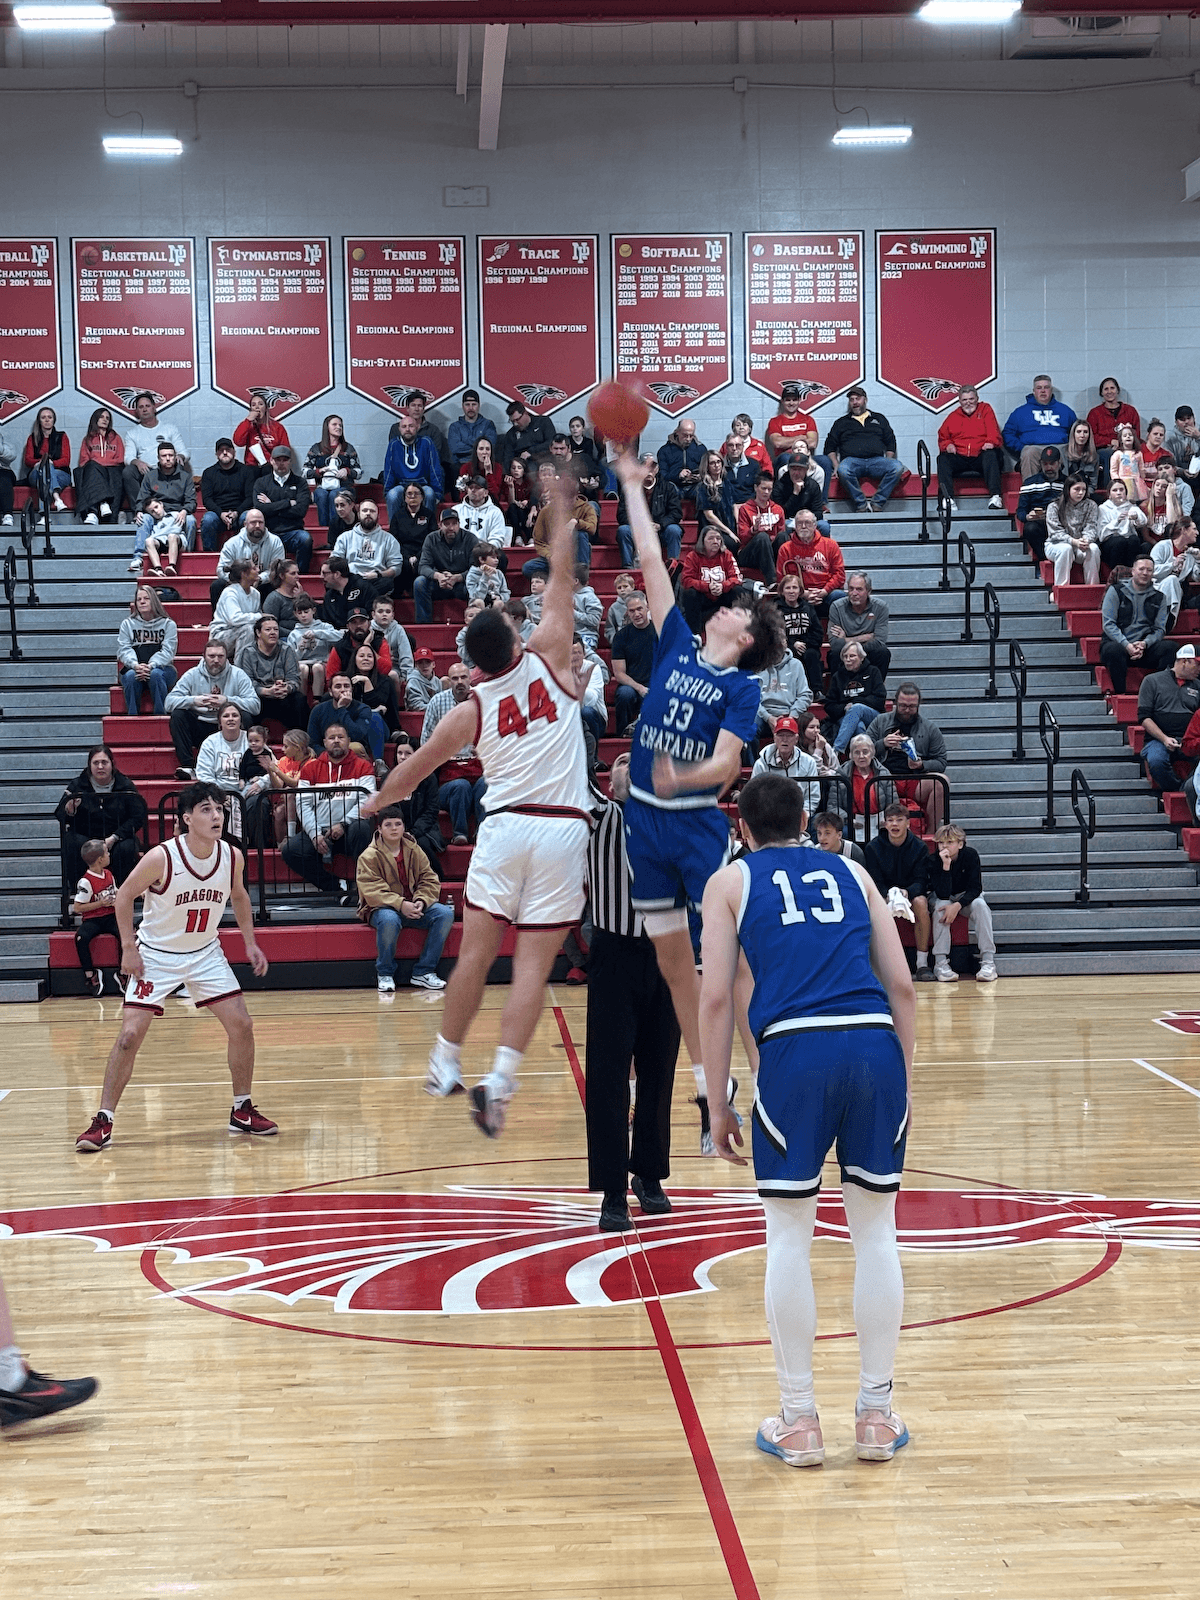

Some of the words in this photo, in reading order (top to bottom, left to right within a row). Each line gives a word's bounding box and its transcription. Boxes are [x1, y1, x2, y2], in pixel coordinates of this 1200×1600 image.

[642, 246, 700, 257] SOFTBALL
[774, 244, 834, 255] BASEBALL
[911, 243, 967, 254] SWIMMING
[102, 250, 167, 261] BASKETBALL
[233, 249, 302, 261] GYMNASTICS
[383, 249, 426, 260] TENNIS
[519, 248, 560, 259] TRACK
[620, 265, 667, 273] SECTIONAL
[670, 265, 721, 273] CHAMPIONS
[935, 261, 986, 269] CHAMPIONS
[269, 268, 321, 276] CHAMPIONS
[404, 268, 455, 276] CHAMPIONS
[490, 324, 533, 333] REGIONAL
[536, 324, 587, 332] CHAMPIONS
[623, 323, 666, 331] REGIONAL
[668, 322, 719, 331] CHAMPIONS
[801, 320, 852, 328] CHAMPIONS
[85, 327, 130, 335] REGIONAL
[132, 327, 185, 335] CHAMPIONS
[221, 326, 265, 335] REGIONAL
[268, 326, 320, 335] CHAMPIONS
[357, 325, 400, 334] REGIONAL
[402, 325, 454, 334] CHAMPIONS
[674, 355, 725, 363] CHAMPIONS
[751, 353, 804, 361] SEMI-STATE
[2, 360, 55, 369] CHAMPIONS
[81, 360, 137, 368] SEMI-STATE
[139, 360, 192, 368] CHAMPIONS
[352, 358, 407, 367] SEMI-STATE
[409, 358, 460, 366] CHAMPIONS
[665, 669, 722, 706] BISHOP
[498, 678, 558, 738] 44
[662, 697, 694, 732] 33
[640, 724, 707, 762] CHATARD
[175, 888, 224, 906] DRAGONS
[772, 869, 844, 926] 13
[185, 908, 210, 933] 11
